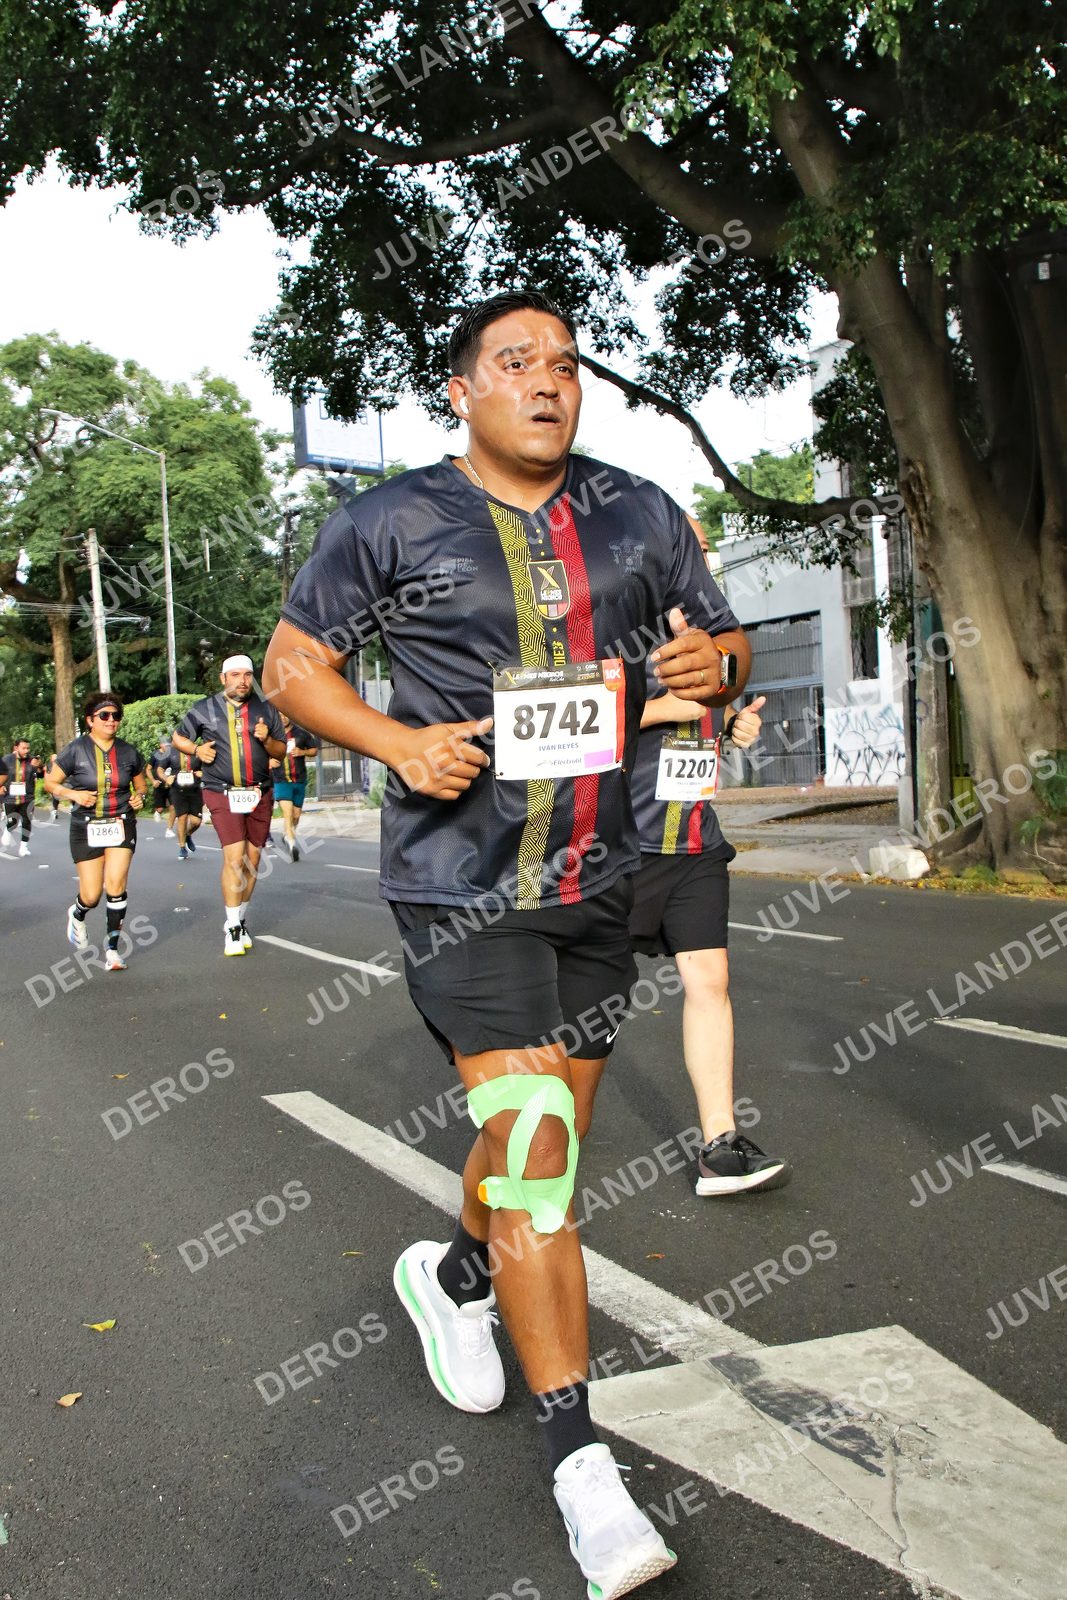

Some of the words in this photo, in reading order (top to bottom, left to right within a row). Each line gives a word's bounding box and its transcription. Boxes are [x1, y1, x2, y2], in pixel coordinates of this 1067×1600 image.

[605, 669, 621, 680] 10K
[513, 699, 599, 740] 8742
[665, 758, 715, 778] 12207
[232, 794, 257, 803] 12867
[91, 826, 119, 837] 12864
